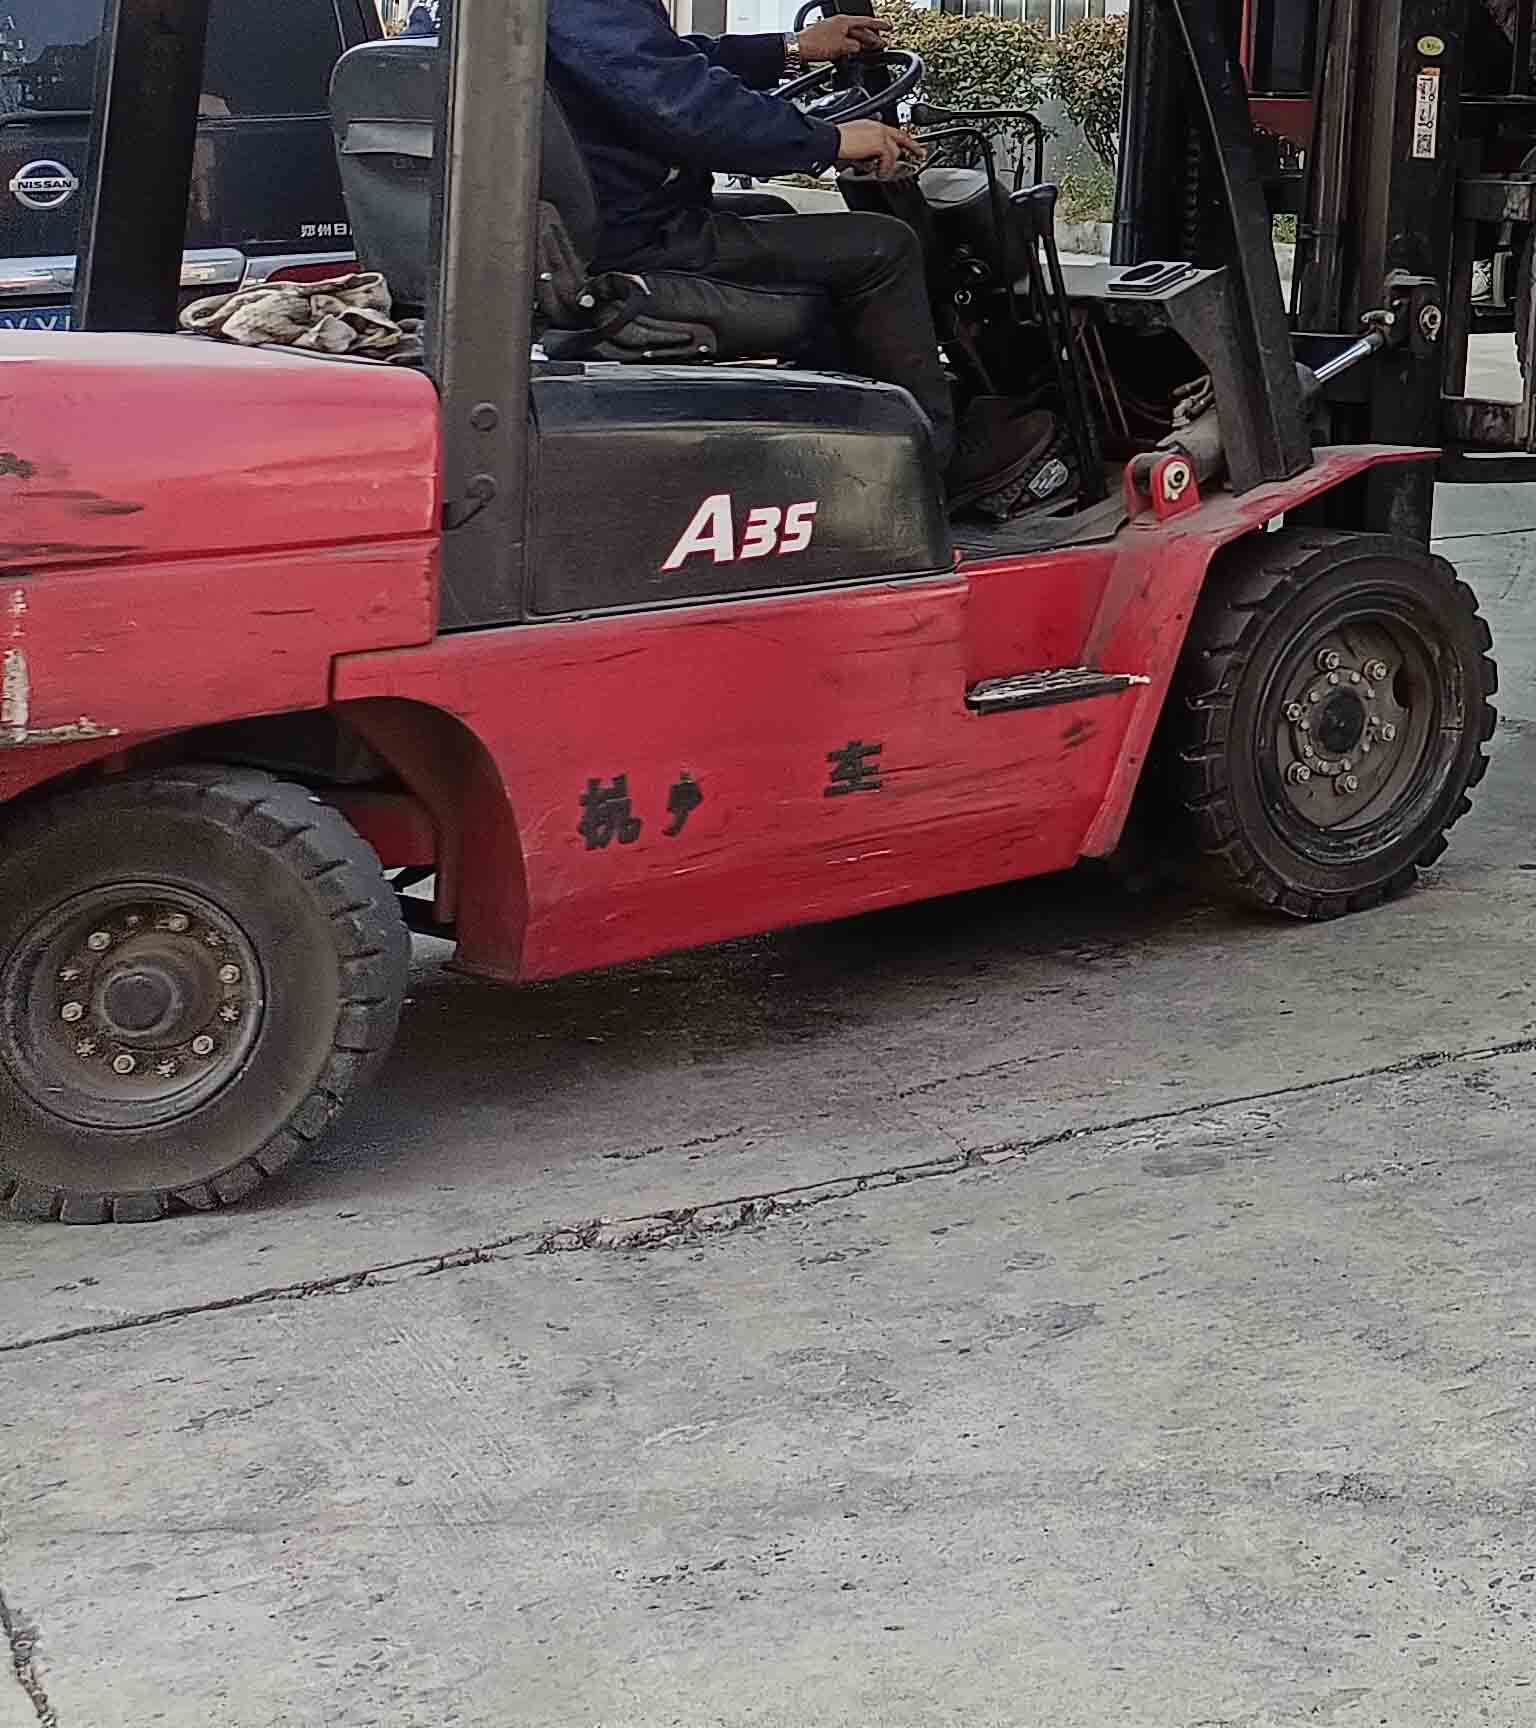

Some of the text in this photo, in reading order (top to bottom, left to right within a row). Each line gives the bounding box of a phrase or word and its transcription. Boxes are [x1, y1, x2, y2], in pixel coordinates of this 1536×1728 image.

[18, 179, 72, 190] NISSAN
[301, 223, 352, 238] 郑州日
[660, 493, 817, 572] A35
